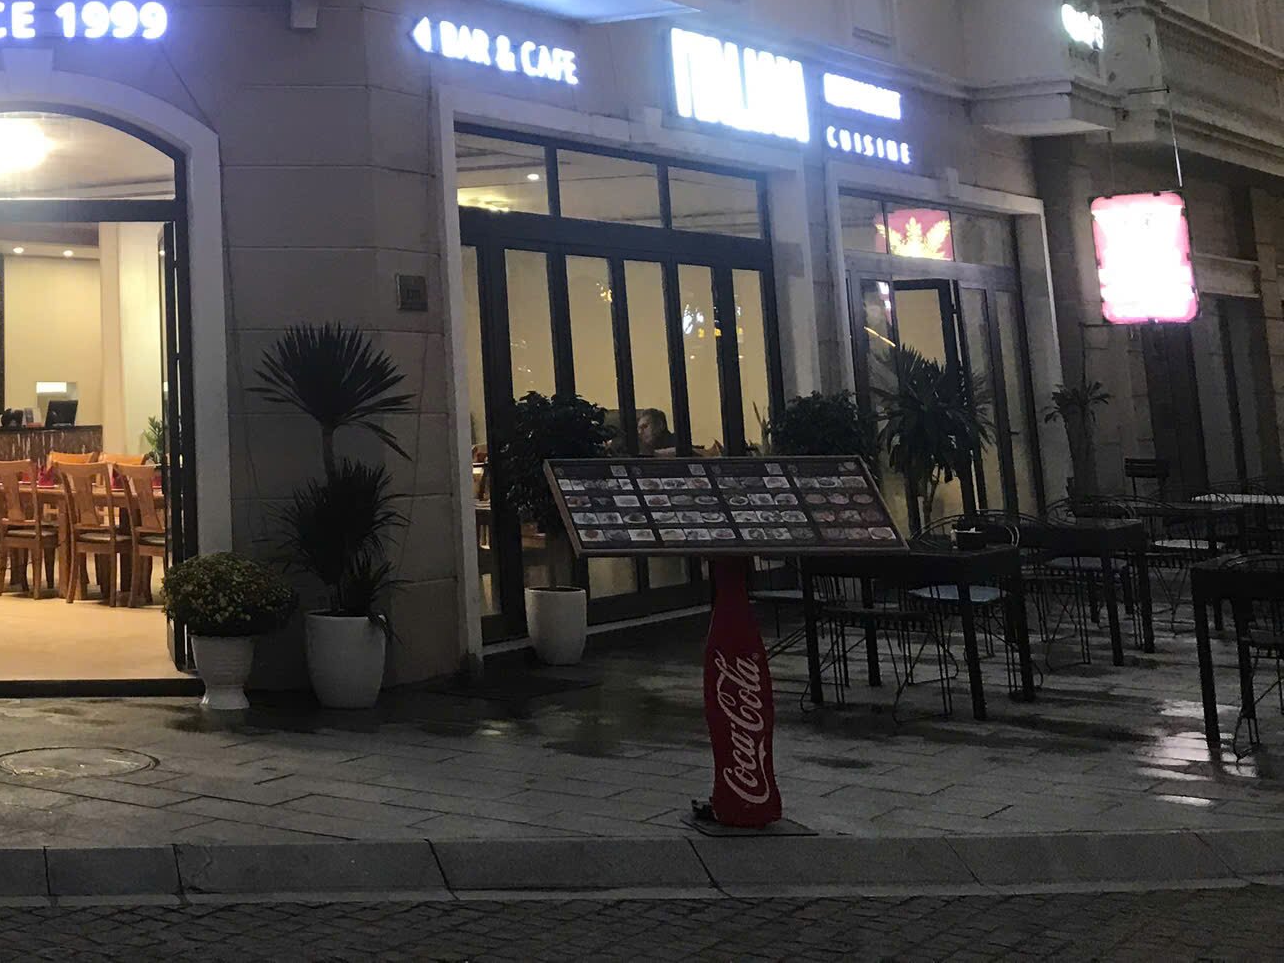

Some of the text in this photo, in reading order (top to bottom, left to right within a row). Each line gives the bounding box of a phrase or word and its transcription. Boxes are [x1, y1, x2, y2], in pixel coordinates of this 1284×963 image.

[55, 0, 168, 39] 1999
[439, 20, 491, 66] BAR
[520, 40, 579, 85] CAFE
[715, 650, 770, 804] Coca-Cola
